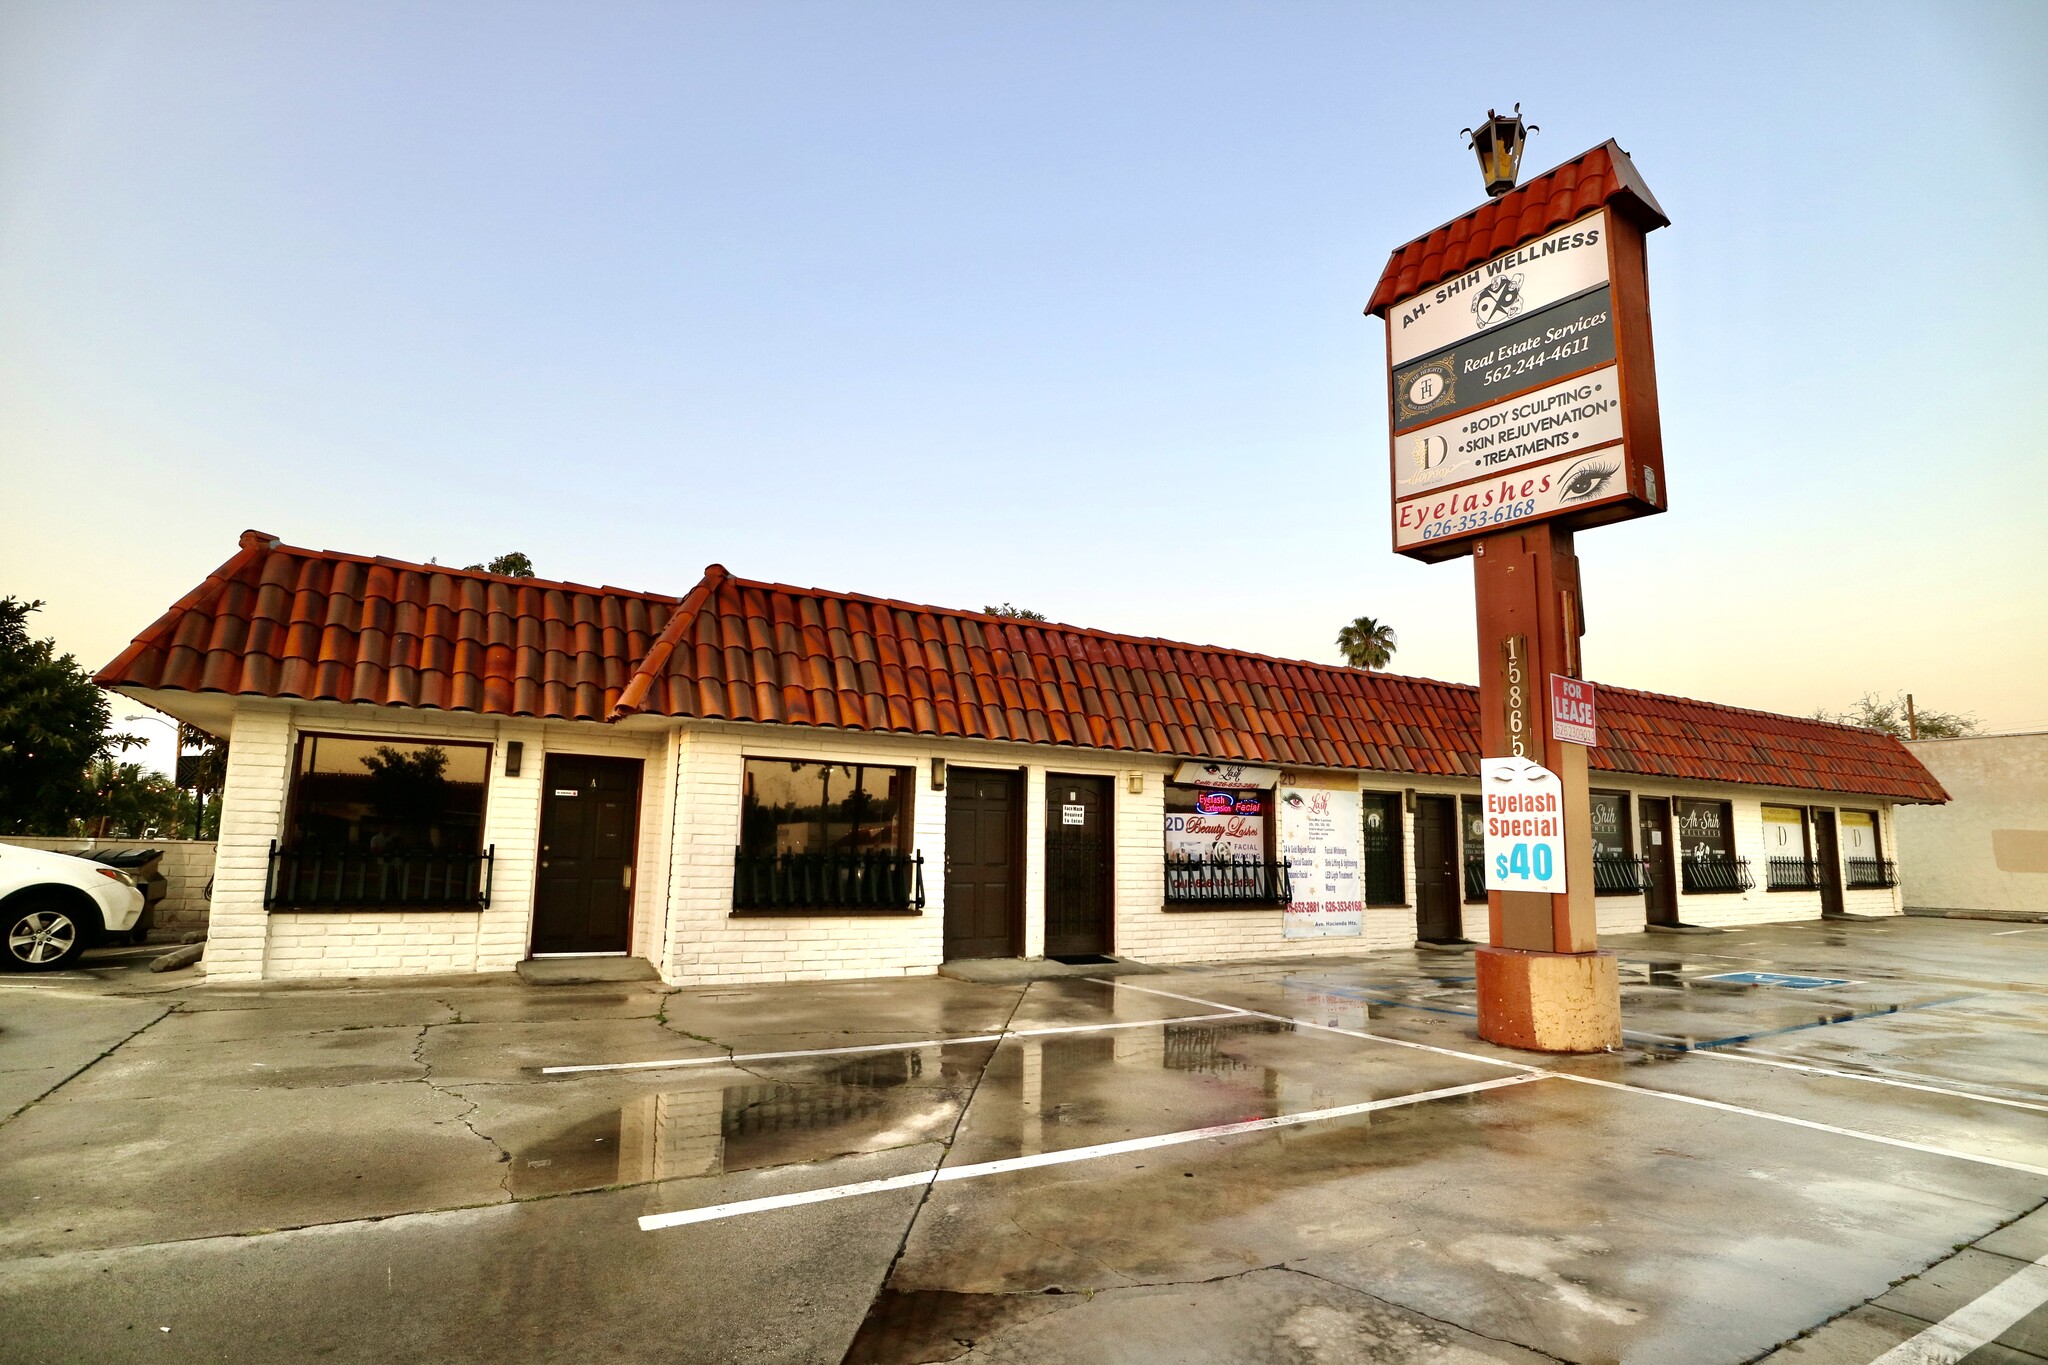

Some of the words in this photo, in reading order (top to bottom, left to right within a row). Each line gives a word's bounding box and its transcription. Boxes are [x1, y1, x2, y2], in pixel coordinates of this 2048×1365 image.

[1435, 270, 1480, 304] SHIH
[1486, 230, 1600, 278] WELLNESS
[1463, 351, 1494, 373] Real
[1498, 336, 1541, 361] Estate
[1544, 311, 1607, 344] Services
[1483, 335, 1589, 386] 562-244-4611
[1466, 434, 1495, 453] SKIN
[1498, 399, 1608, 444] REJUVENATION
[1470, 411, 1509, 434] BODY
[1512, 385, 1592, 421] SCULPTING
[1483, 431, 1570, 467] TREATMENTS
[1400, 474, 1551, 530] Eyelashes
[1423, 498, 1535, 540] 626-353-6168
[1507, 636, 1525, 758] 15865
[1563, 681, 1582, 699] FOR
[1555, 696, 1593, 725] LEASE
[1199, 794, 1225, 805] Eyelash
[1205, 803, 1231, 813] Extension
[1235, 802, 1261, 812] Facial
[1488, 792, 1556, 815] Eyelash
[1166, 816, 1185, 832] 2D
[1185, 816, 1226, 841] Beauty
[1225, 816, 1258, 838] Lashes
[1489, 817, 1557, 838] Special
[1496, 843, 1553, 881] $40
[1325, 901, 1362, 912] 626-353-6168
